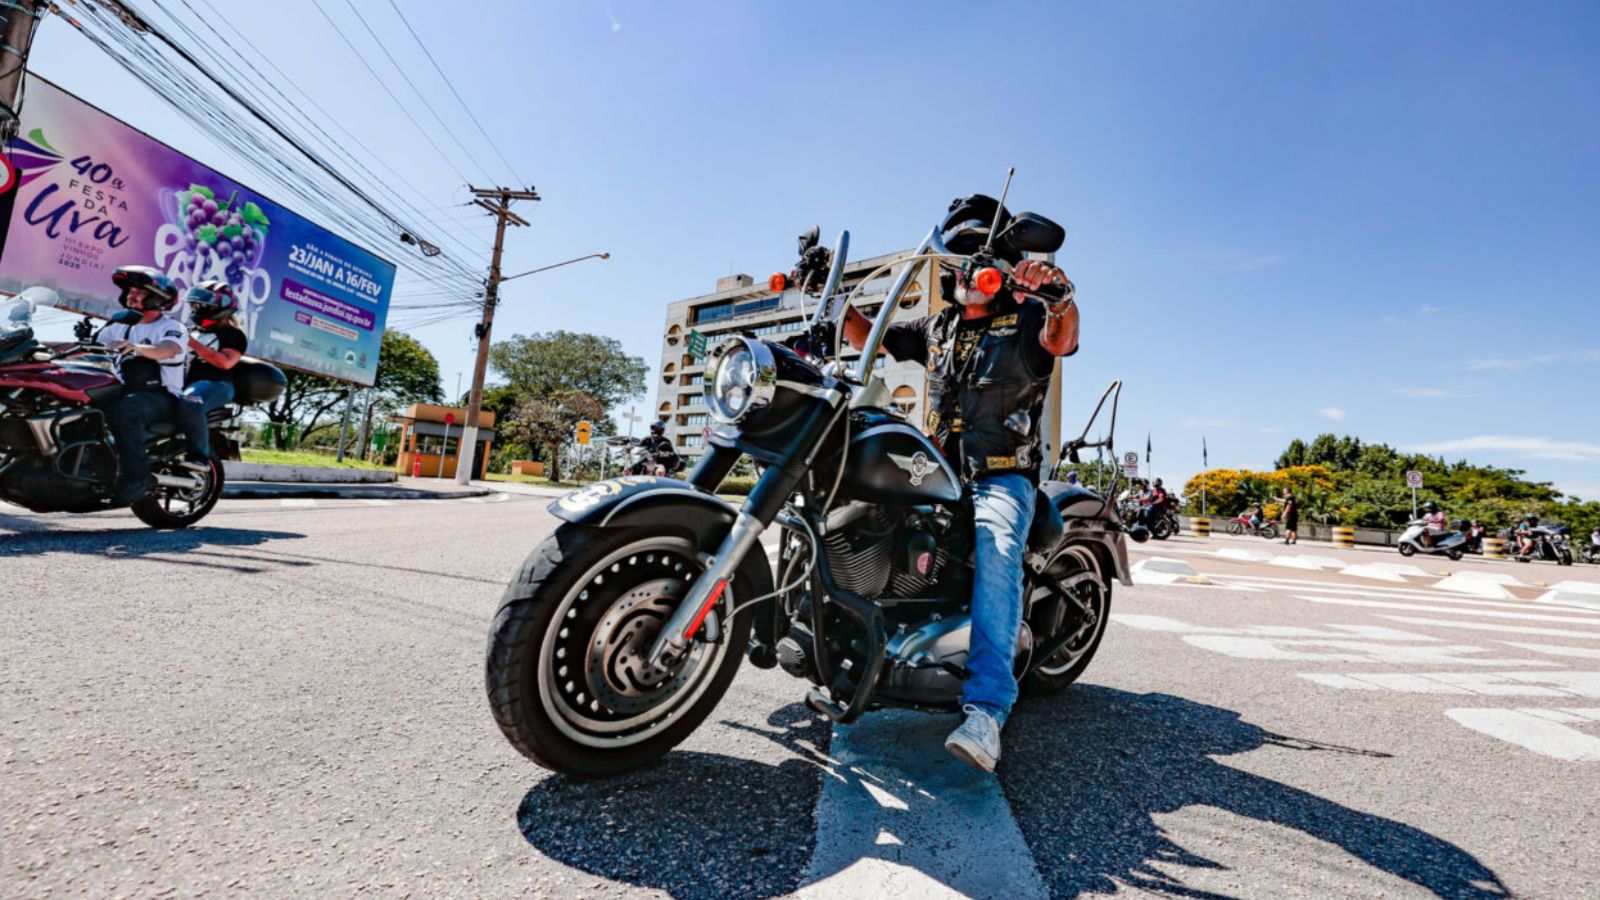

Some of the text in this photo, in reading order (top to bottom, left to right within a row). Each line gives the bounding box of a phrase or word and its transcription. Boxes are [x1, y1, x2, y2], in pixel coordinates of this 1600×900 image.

[24, 183, 130, 248] Uva
[69, 179, 128, 211] FESTA
[84, 198, 108, 216] DA
[289, 244, 334, 276] 23/JAN
[335, 267, 344, 282] A
[346, 271, 382, 297] 16/FEV
